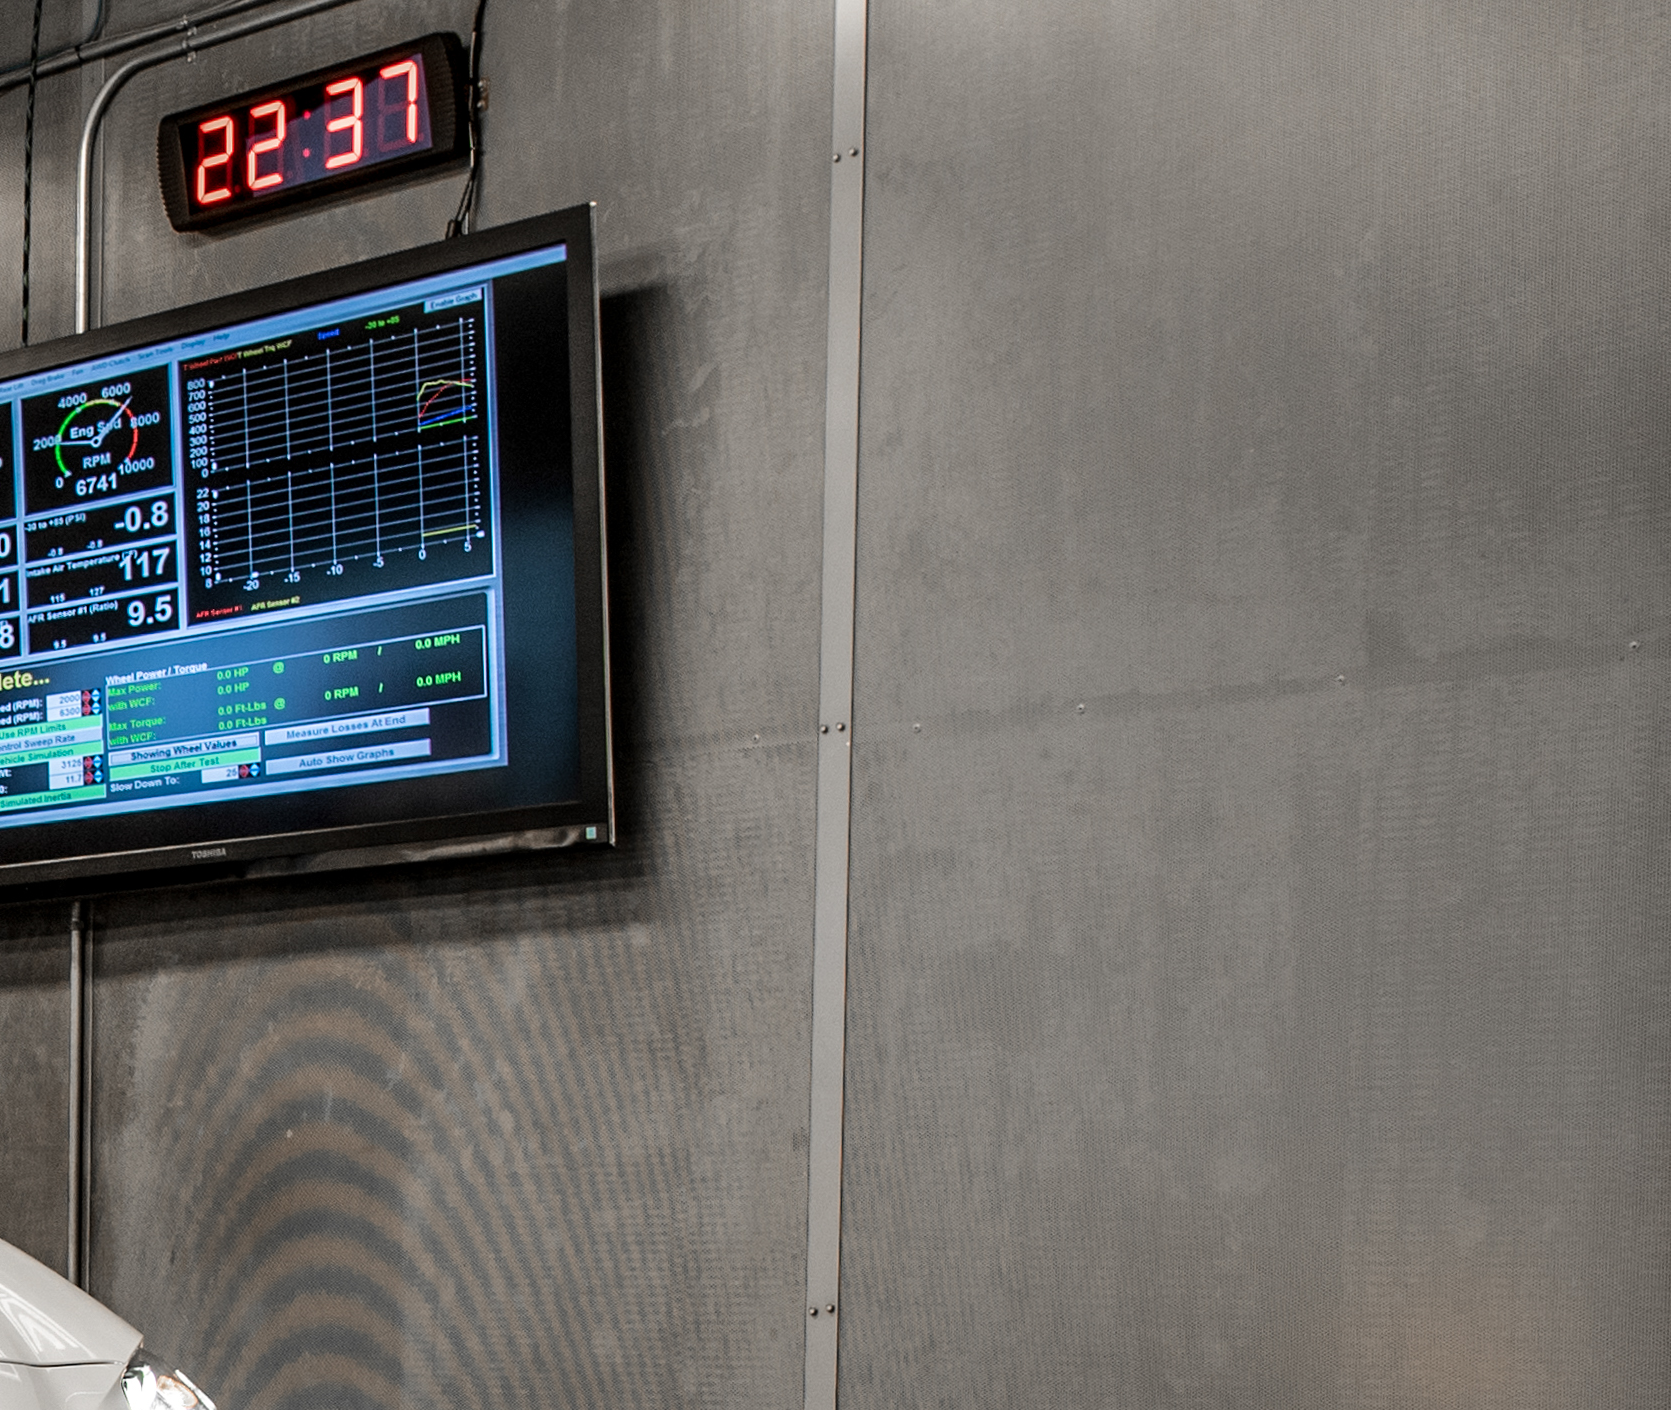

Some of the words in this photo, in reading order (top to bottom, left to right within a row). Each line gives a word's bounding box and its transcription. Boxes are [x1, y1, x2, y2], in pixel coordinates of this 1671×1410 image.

[197, 58, 419, 206] 22:37
[101, 382, 131, 398] 6000
[187, 378, 205, 390] 800
[58, 392, 87, 409] 4000
[188, 390, 205, 401] 700
[188, 401, 206, 413] 600
[130, 412, 160, 428] 8000
[189, 412, 206, 424] 500
[70, 426, 94, 440] Eng
[189, 424, 207, 435] 400
[33, 434, 62, 451] 2000
[189, 435, 207, 447] 300
[190, 446, 207, 458] 200
[82, 453, 111, 469] RPM
[118, 457, 155, 476] 10000
[191, 457, 208, 469] 100
[55, 478, 64, 489] 0
[76, 472, 118, 496] 6741
[196, 488, 209, 499] 22
[114, 501, 170, 533] -0.8
[66, 553, 121, 571] Temperature
[119, 547, 171, 581] 117
[46, 606, 76, 620] Sensor
[89, 600, 118, 614] (Ratio)
[127, 594, 173, 627] 9.5
[216, 669, 232, 680] 0.0
[233, 666, 249, 677] HP
[272, 661, 285, 674] @
[323, 653, 331, 664] 0
[332, 650, 358, 663] RPM
[415, 638, 432, 650] 0.0
[433, 633, 461, 648] MPH
[105, 671, 135, 685] Wheel
[136, 667, 166, 681] Power
[173, 661, 208, 675] Torque
[128, 682, 162, 695] Power:
[217, 684, 232, 695] 0.0
[233, 682, 250, 693] HP
[217, 705, 233, 716] 0.0
[234, 702, 267, 714] Ft-Lbs
[273, 697, 286, 710] @
[324, 690, 332, 701] 0
[333, 686, 359, 700] RPM
[416, 675, 433, 688] 0.0
[435, 671, 462, 685] MPH
[13, 698, 44, 712] (RPM):
[59, 695, 79, 705] 2000
[13, 711, 44, 725] (RPM):
[129, 717, 167, 730] Torque:
[218, 719, 234, 731] 0.0
[235, 716, 268, 729] Ft-Lbs
[17, 728, 38, 738] RPM
[39, 723, 67, 735] Limits
[286, 726, 329, 740] Measure
[331, 721, 368, 734] Losses
[371, 718, 383, 729] At
[385, 715, 406, 726] End
[24, 737, 53, 750] Sweep
[55, 735, 76, 744] Rate
[131, 748, 171, 761] Showing
[173, 743, 202, 756] Wheel
[205, 738, 237, 751] Values
[28, 748, 74, 762] Simulation
[299, 757, 323, 769] Auto
[326, 753, 354, 766] Show
[357, 747, 395, 763] Graphs
[150, 762, 172, 774] Stop
[173, 759, 196, 770] After
[199, 757, 220, 767] Test
[226, 768, 238, 778] 25
[110, 780, 133, 793] Slow
[134, 777, 163, 790] Down
[165, 776, 180, 786] To:
[0, 796, 42, 809] Simulated
[44, 791, 72, 804] Inertia
